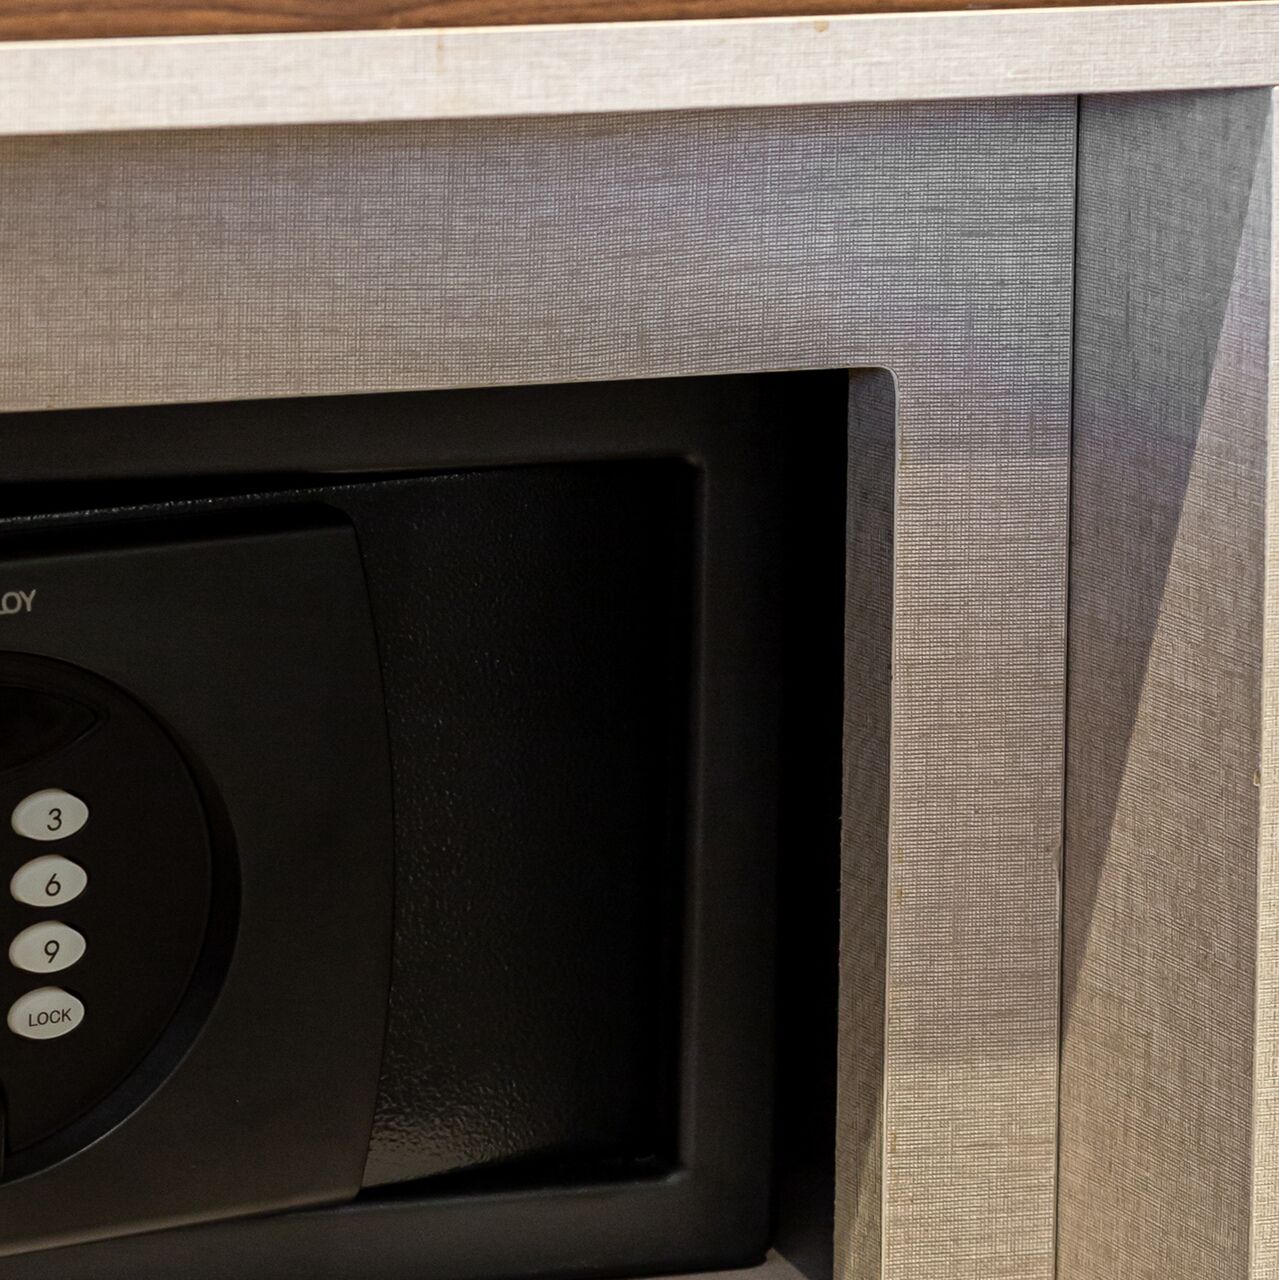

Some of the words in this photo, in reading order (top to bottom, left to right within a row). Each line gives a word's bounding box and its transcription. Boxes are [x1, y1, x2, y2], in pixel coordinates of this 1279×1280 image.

[46, 807, 63, 832] 3
[44, 872, 62, 897] 6
[43, 939, 60, 964] 9
[28, 1007, 72, 1027] LOCK
